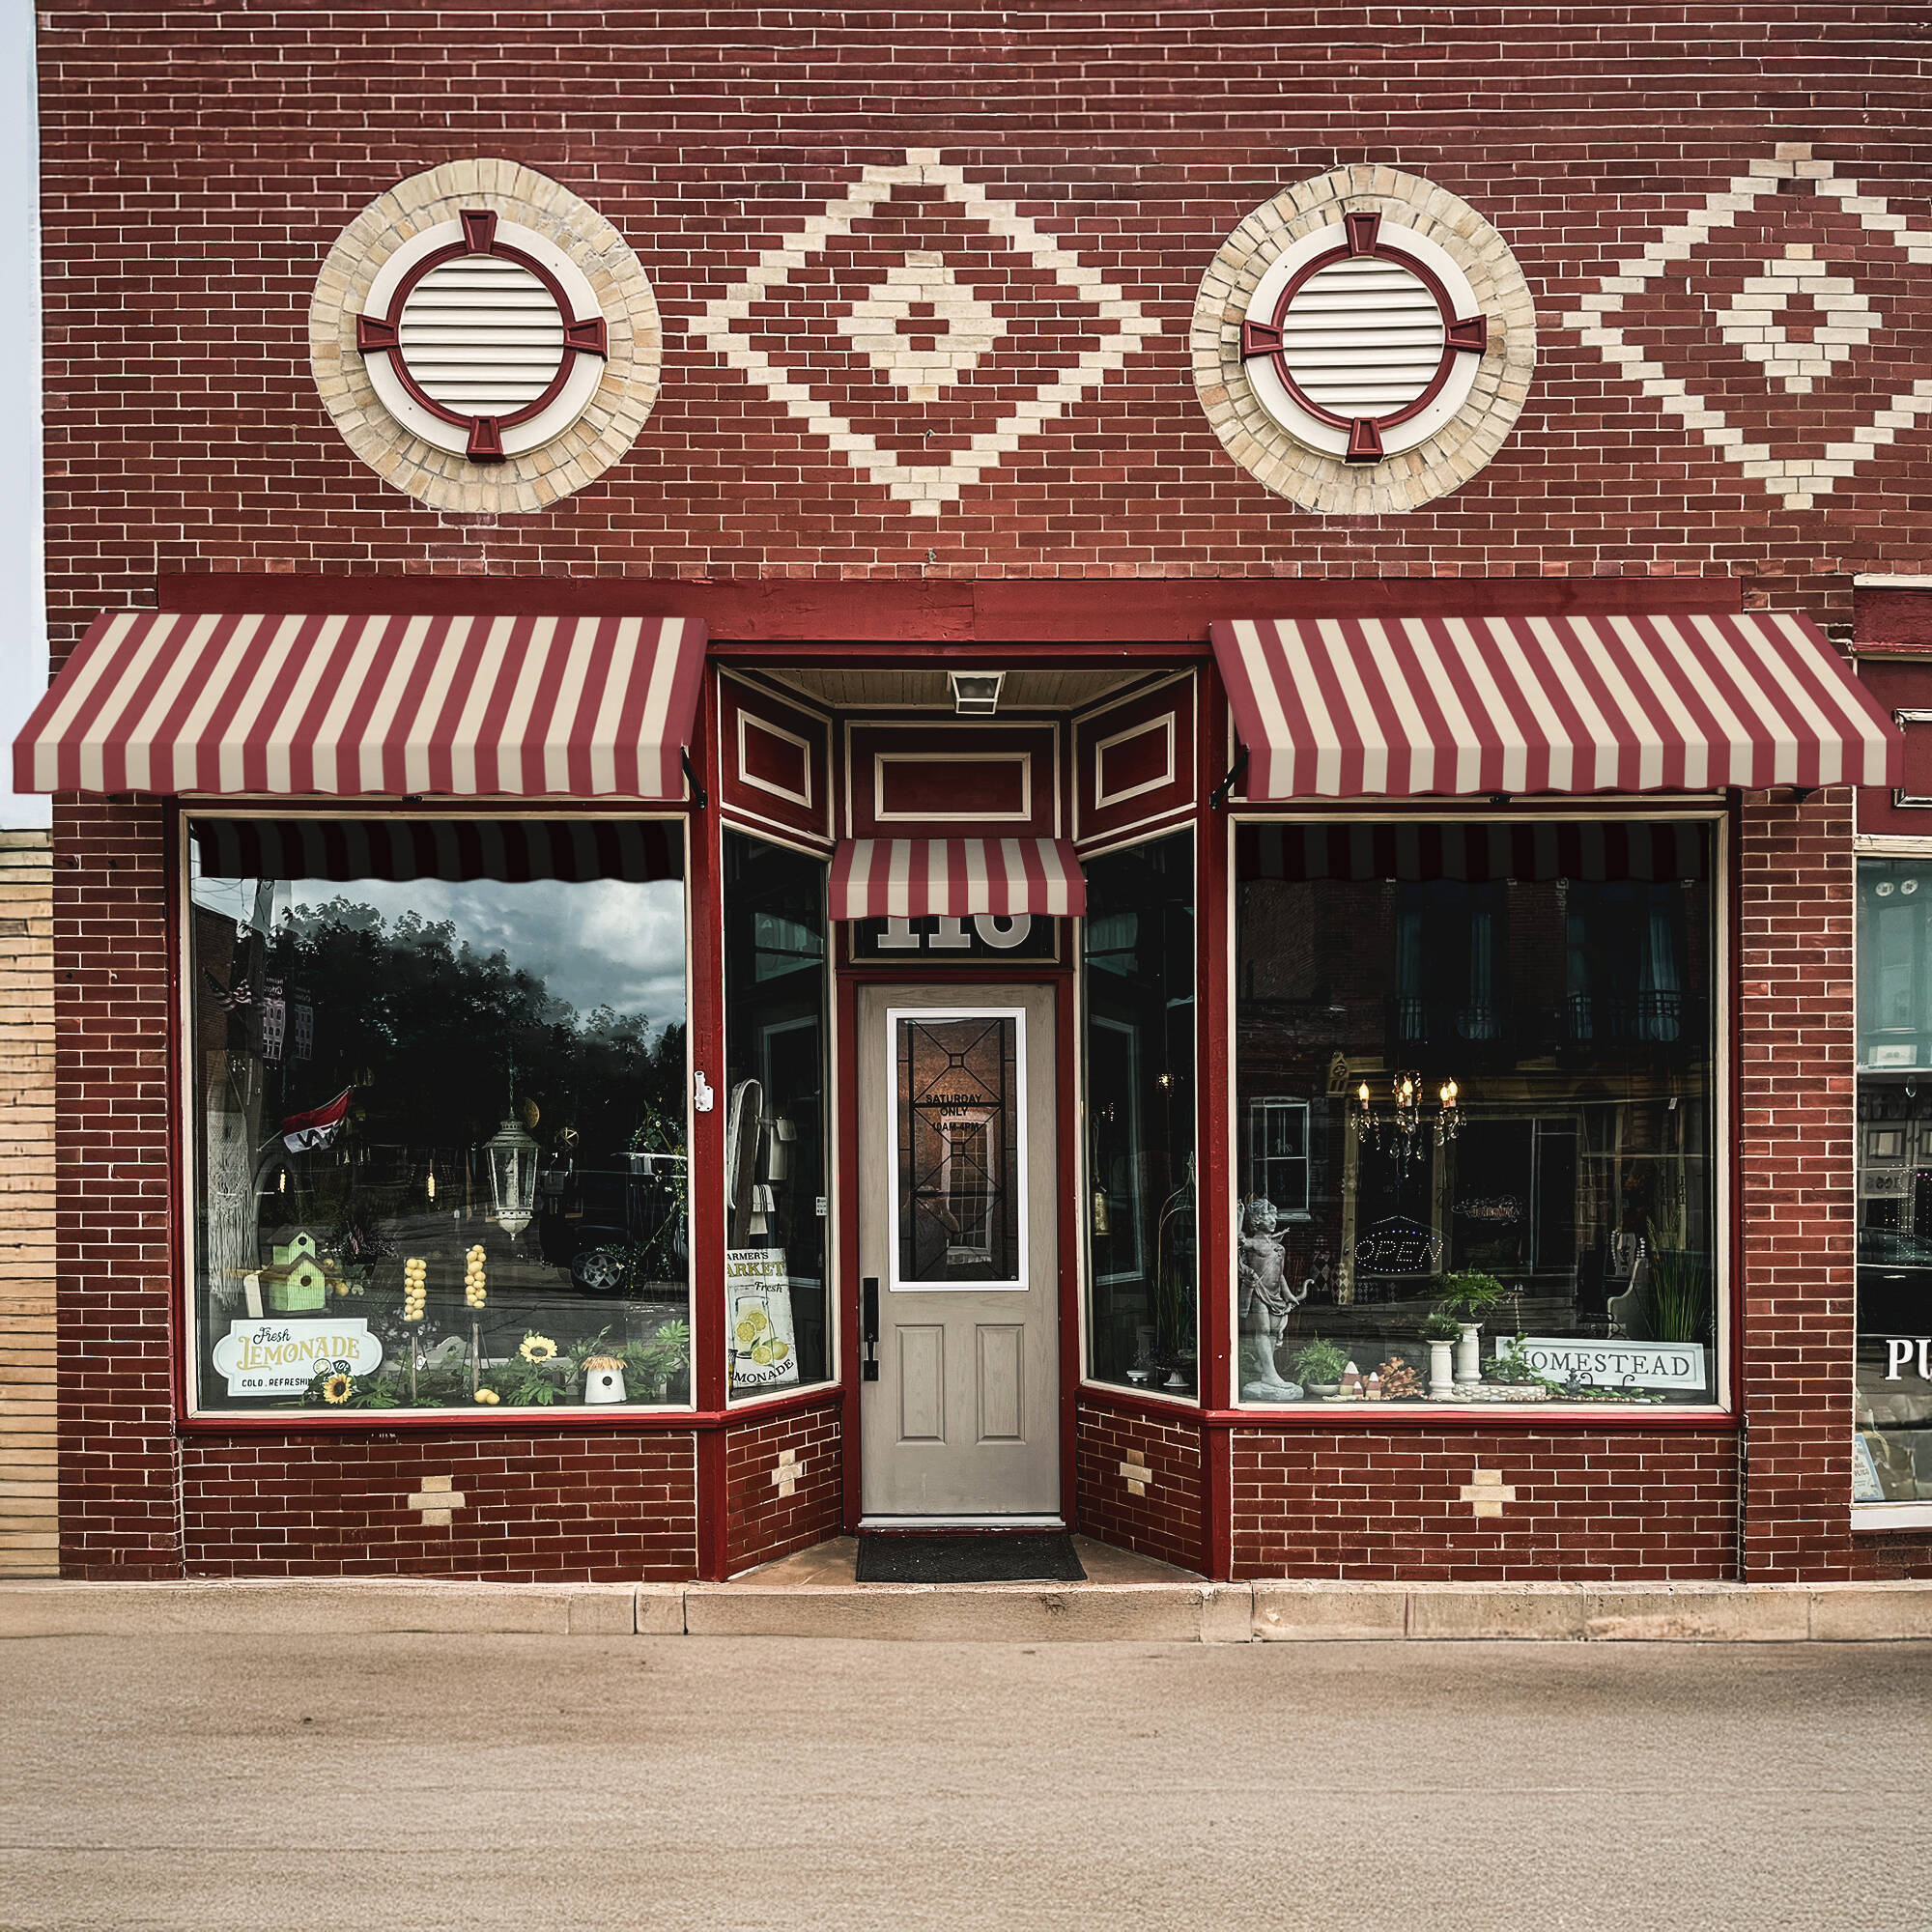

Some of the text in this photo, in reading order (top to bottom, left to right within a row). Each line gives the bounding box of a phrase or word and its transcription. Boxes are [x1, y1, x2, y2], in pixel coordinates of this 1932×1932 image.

[925, 1094, 982, 1103] SATURDAY
[940, 1106, 969, 1116] ONLY
[1354, 1239, 1444, 1264] OPEN
[754, 1281, 782, 1293] Fresh
[253, 1327, 291, 1345] Fresh
[237, 1336, 359, 1371] LEMONADE
